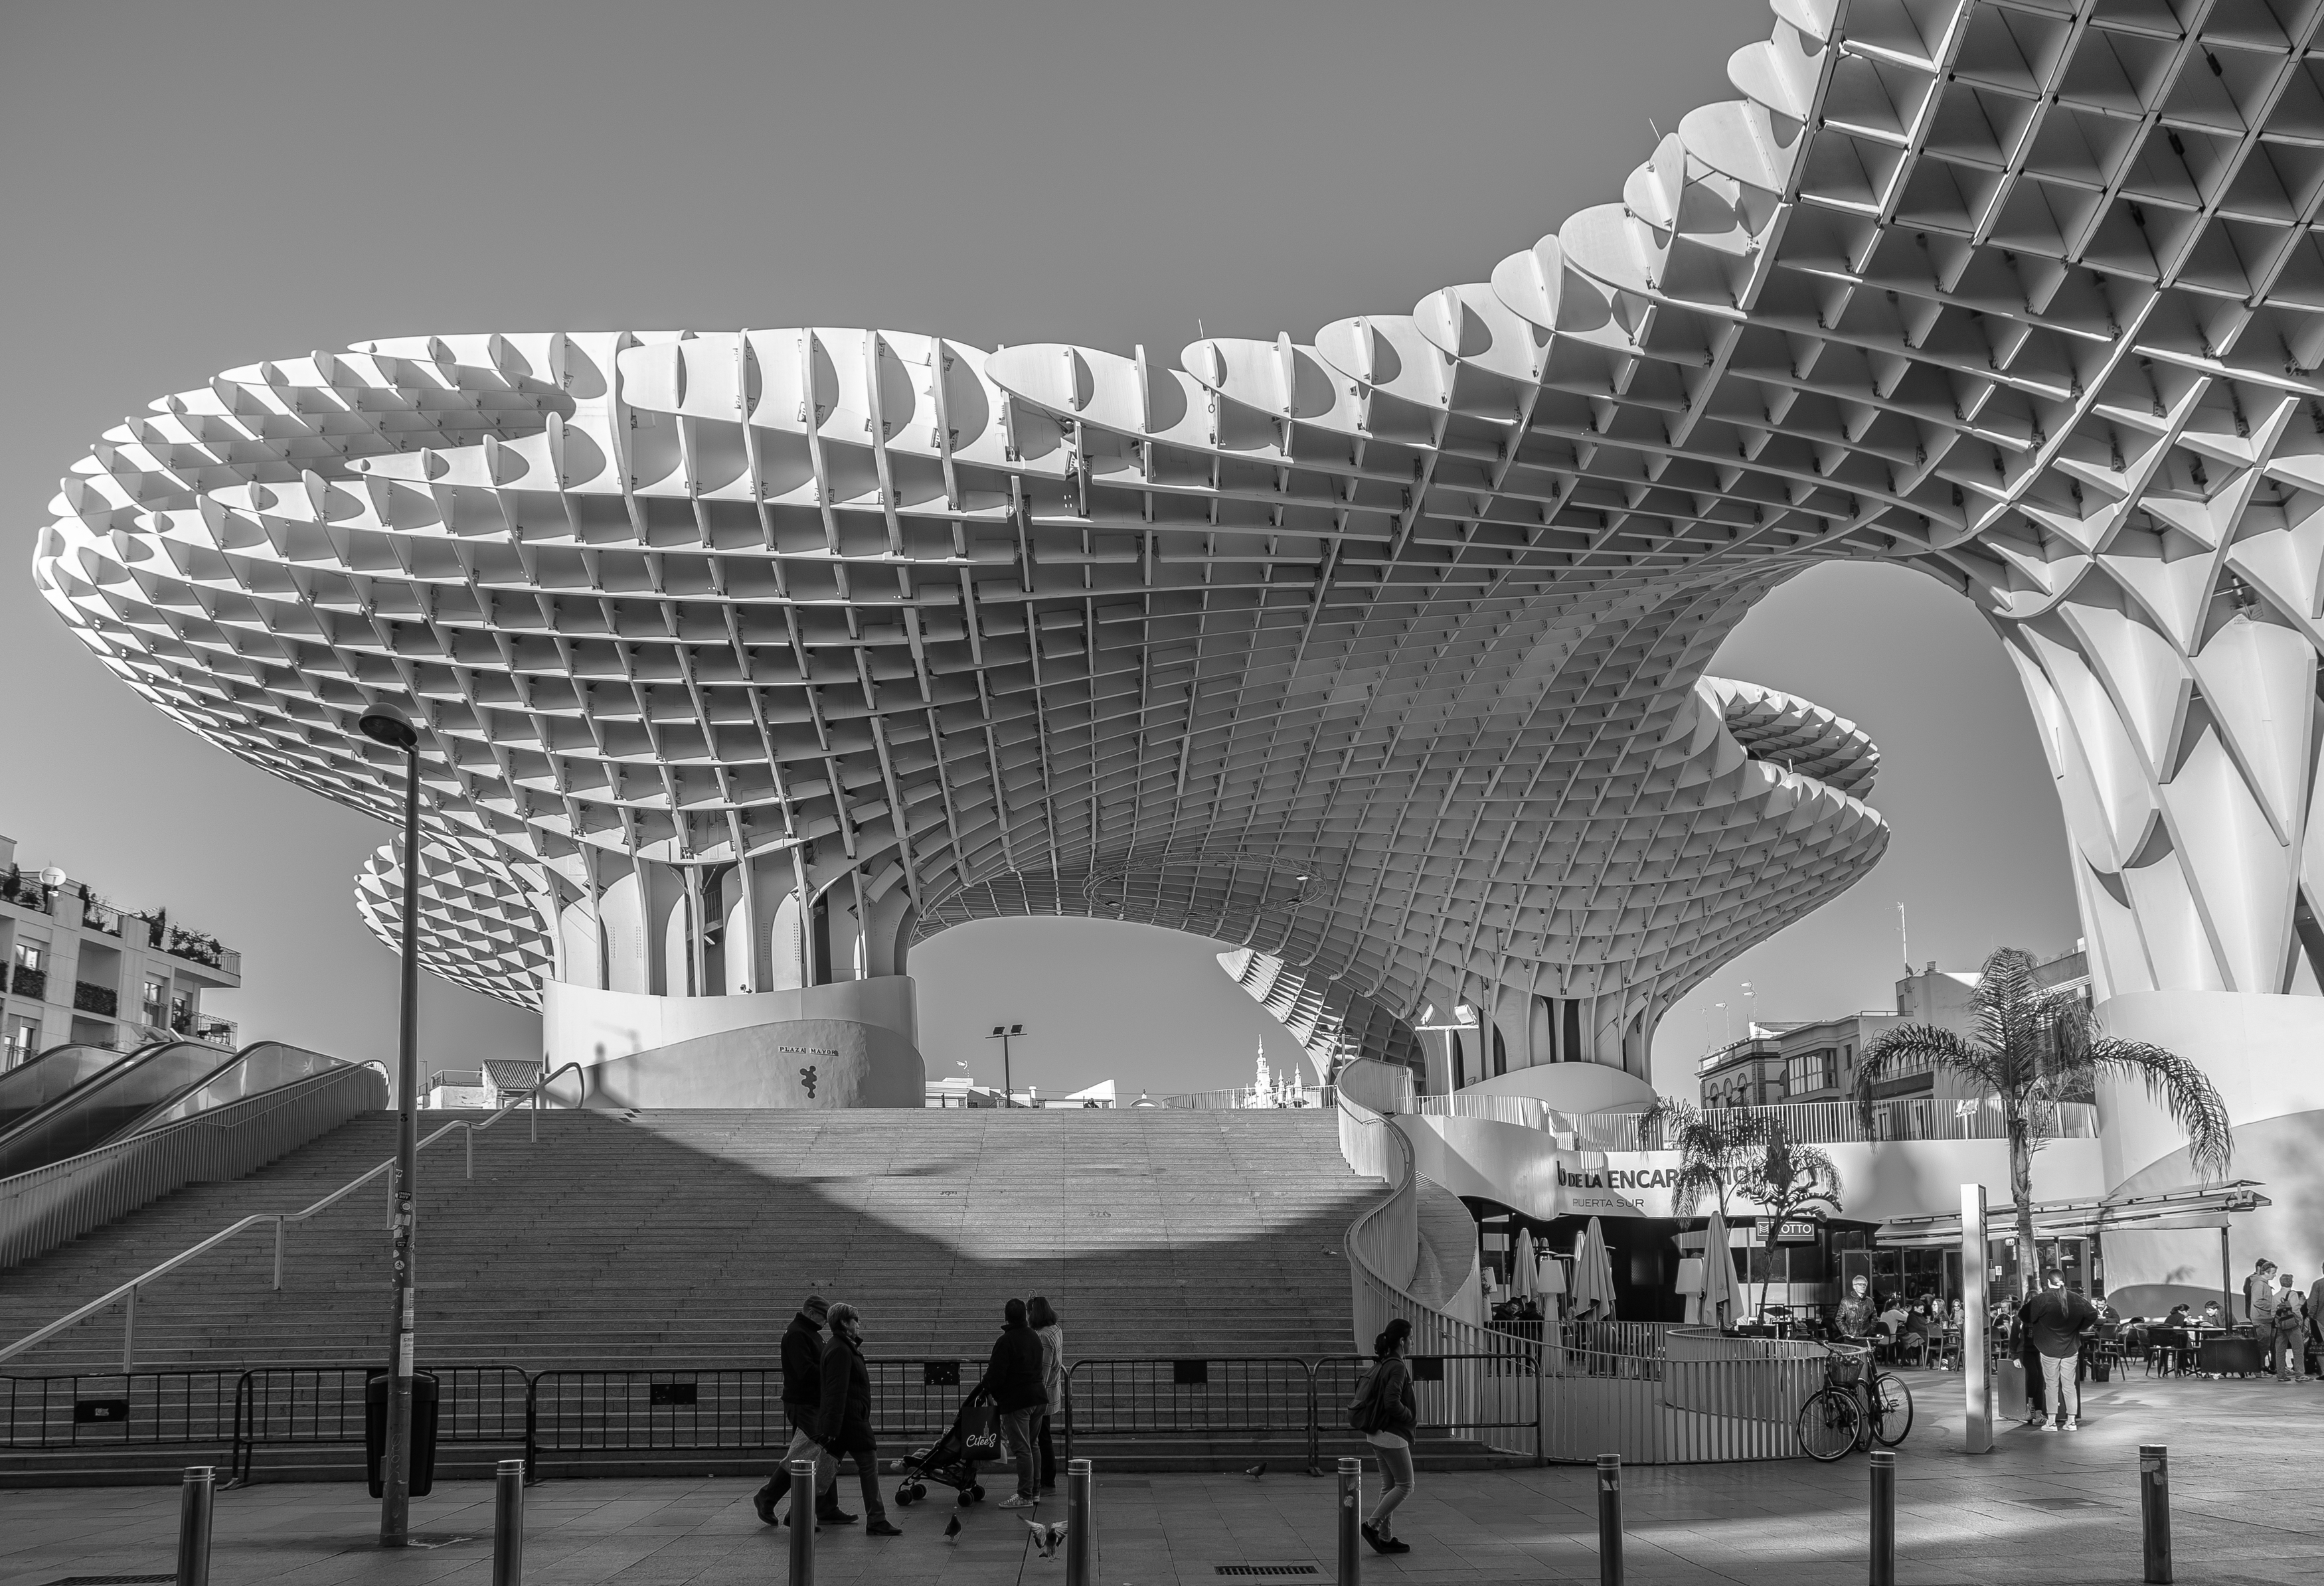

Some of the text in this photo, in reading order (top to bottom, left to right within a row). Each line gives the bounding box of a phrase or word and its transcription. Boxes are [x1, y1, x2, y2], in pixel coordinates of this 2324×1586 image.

[400, 1113, 408, 1122] 3
[1568, 1172, 1584, 1188] DE
[1585, 1173, 1604, 1188] LA
[1572, 1198, 1645, 1208] PUERTA SUR
